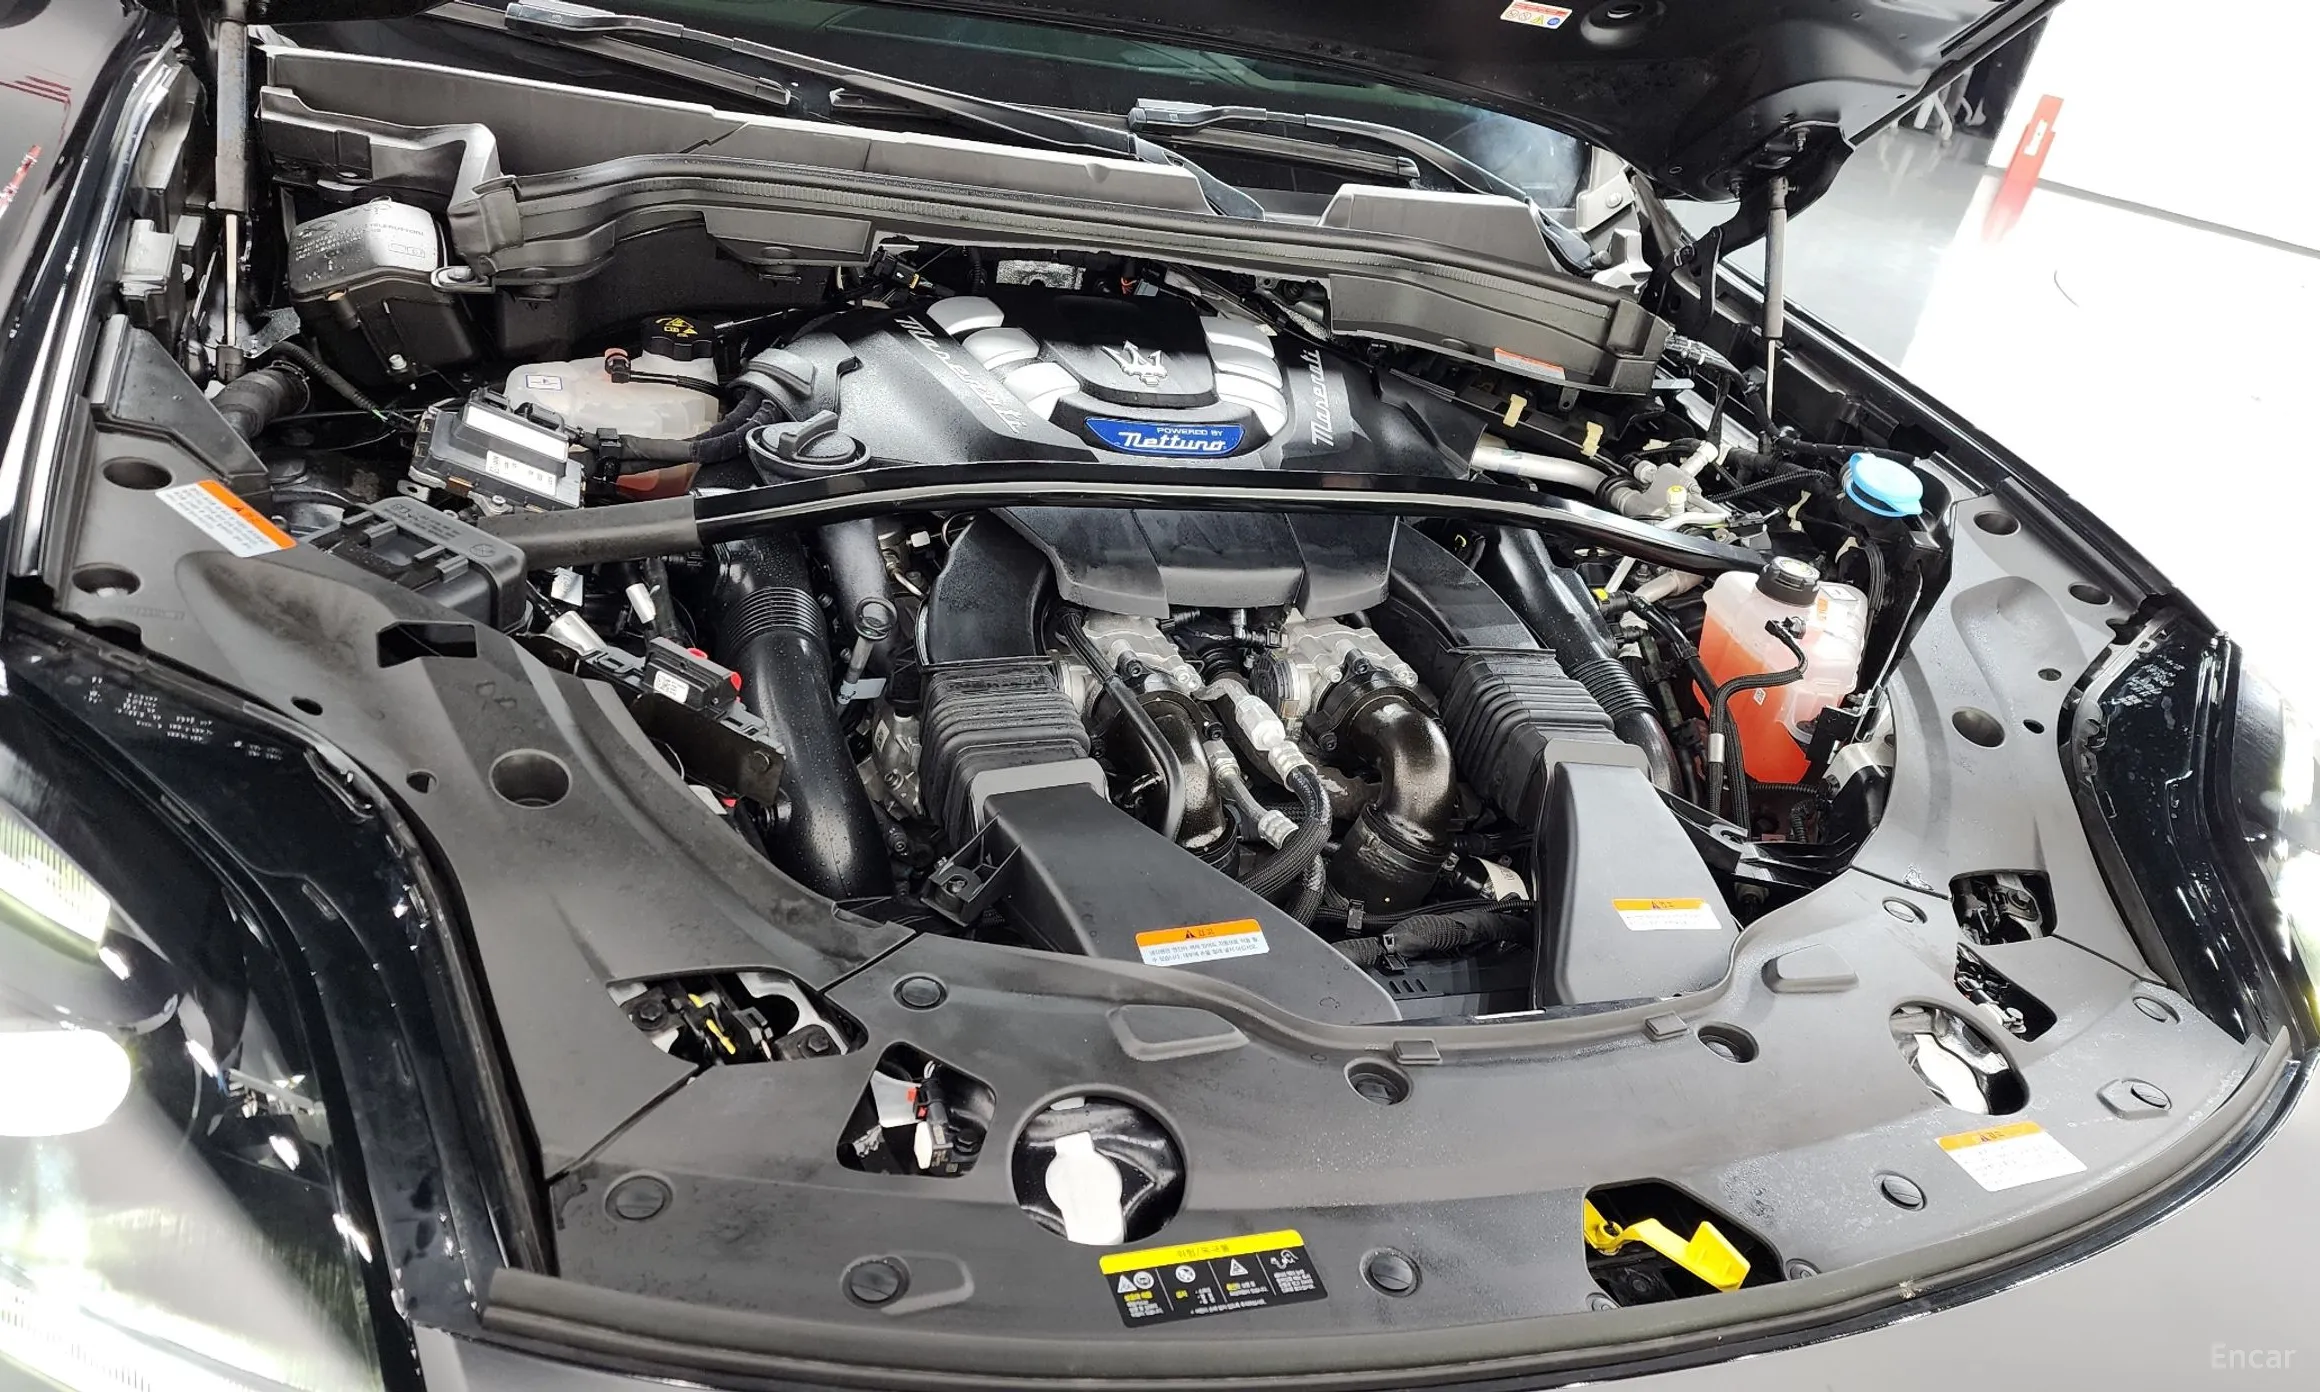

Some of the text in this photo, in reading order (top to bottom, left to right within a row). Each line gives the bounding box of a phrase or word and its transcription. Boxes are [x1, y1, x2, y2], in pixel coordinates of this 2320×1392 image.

[894, 315, 1027, 434] Maserati
[1300, 349, 1335, 447] Maserati
[1118, 432, 1226, 451] Nettuno
[1156, 427, 1224, 437] POWERED BY
